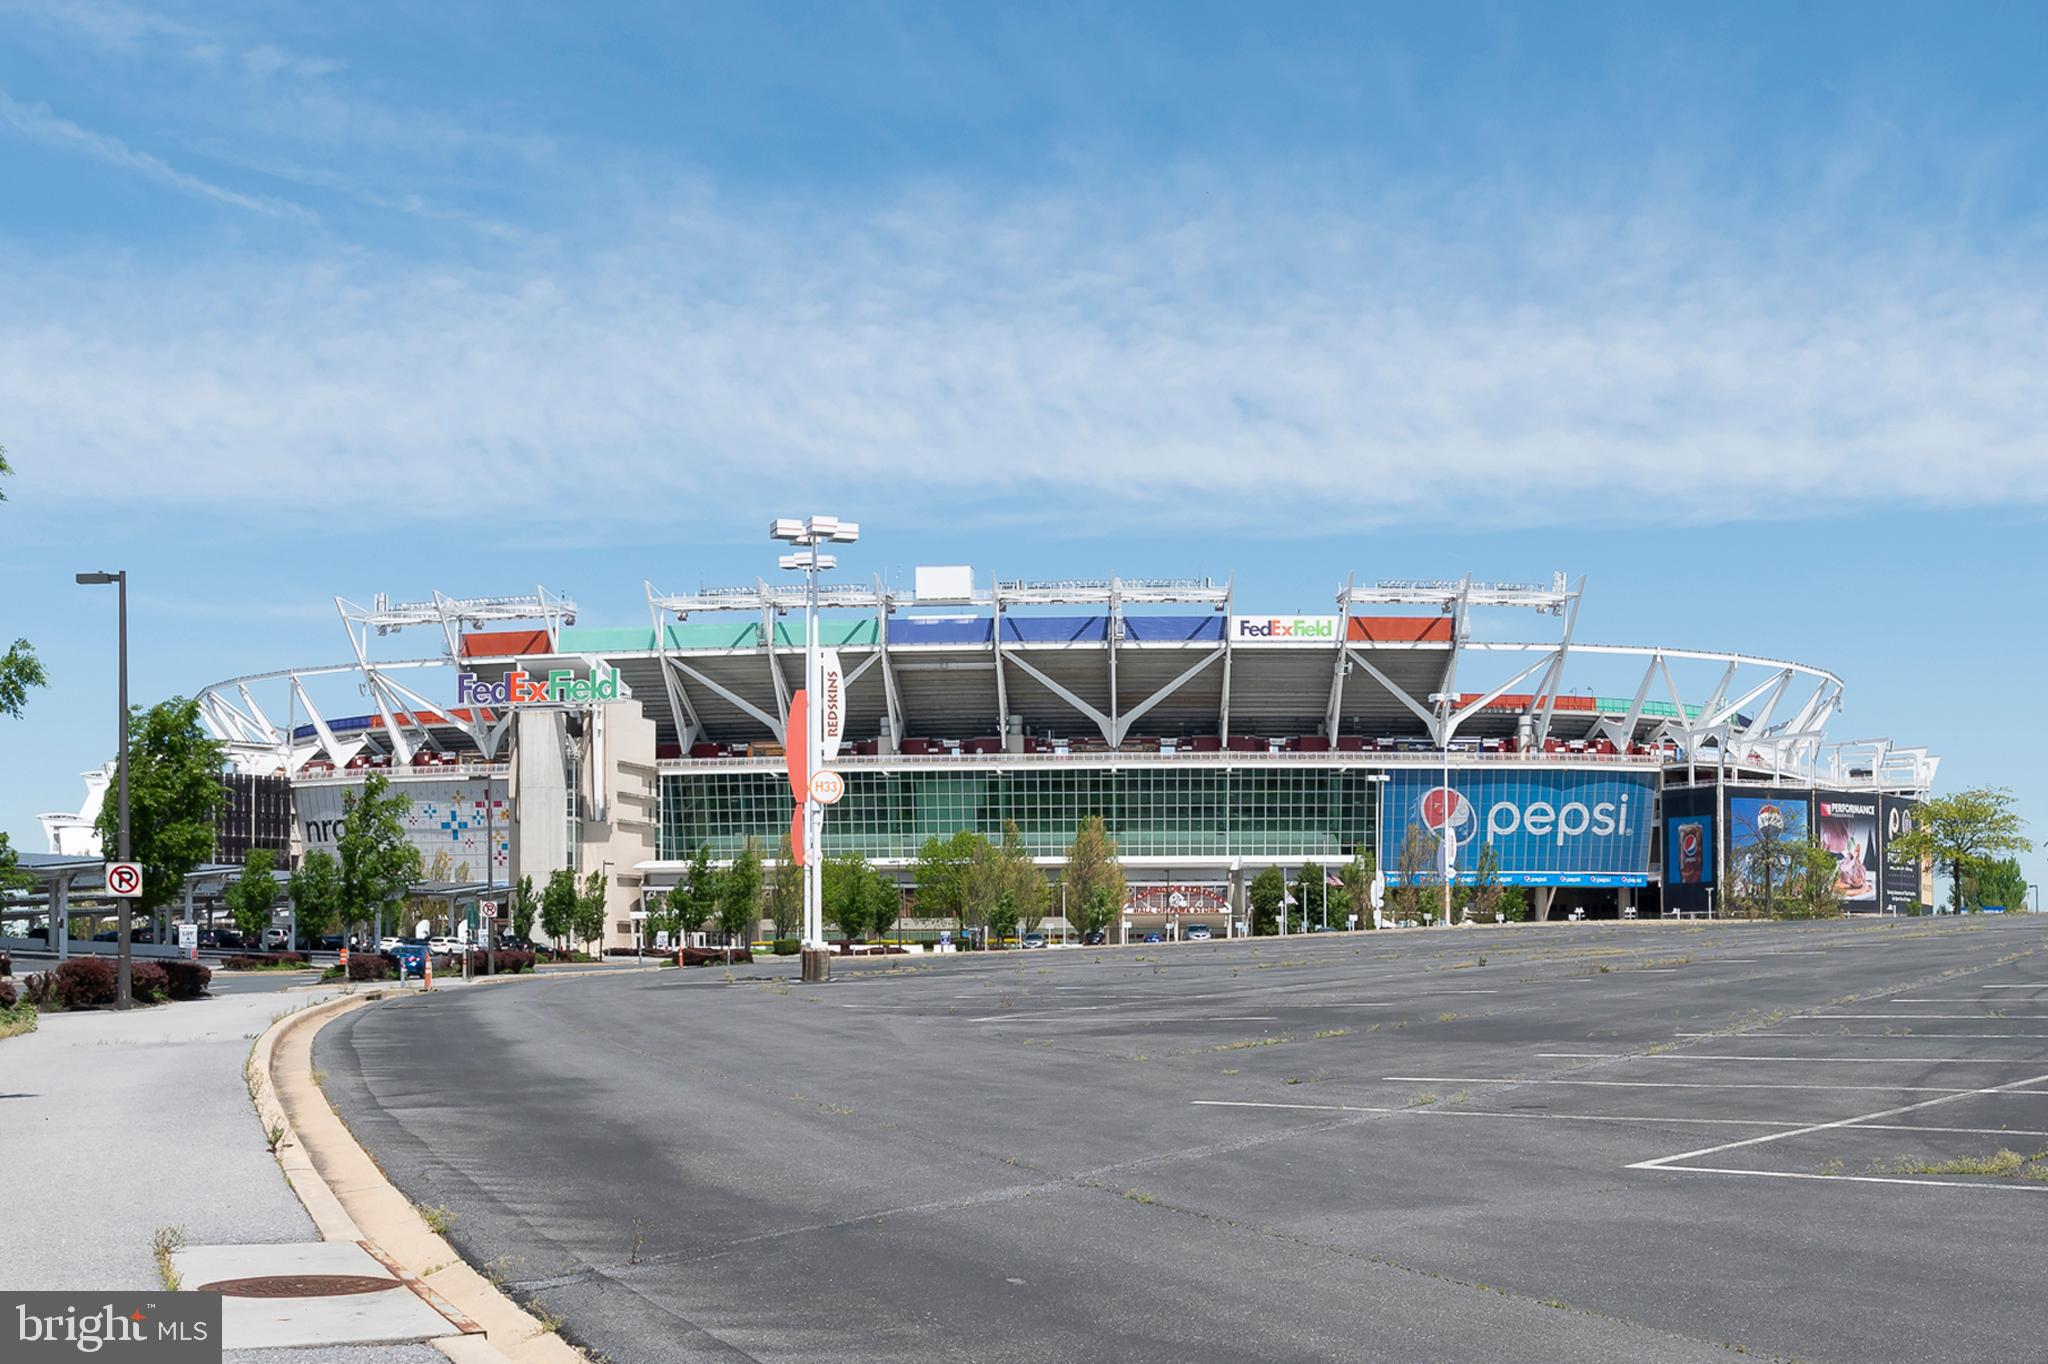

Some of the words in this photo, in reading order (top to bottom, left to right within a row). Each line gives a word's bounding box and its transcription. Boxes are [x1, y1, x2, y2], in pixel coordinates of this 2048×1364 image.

[1240, 619, 1332, 637] FedExField
[457, 668, 618, 704] FedExField
[827, 671, 838, 738] REDSKINS
[815, 781, 837, 793] H33
[1487, 793, 1628, 846] pepsi
[1831, 802, 1875, 816] PERFORMANCE
